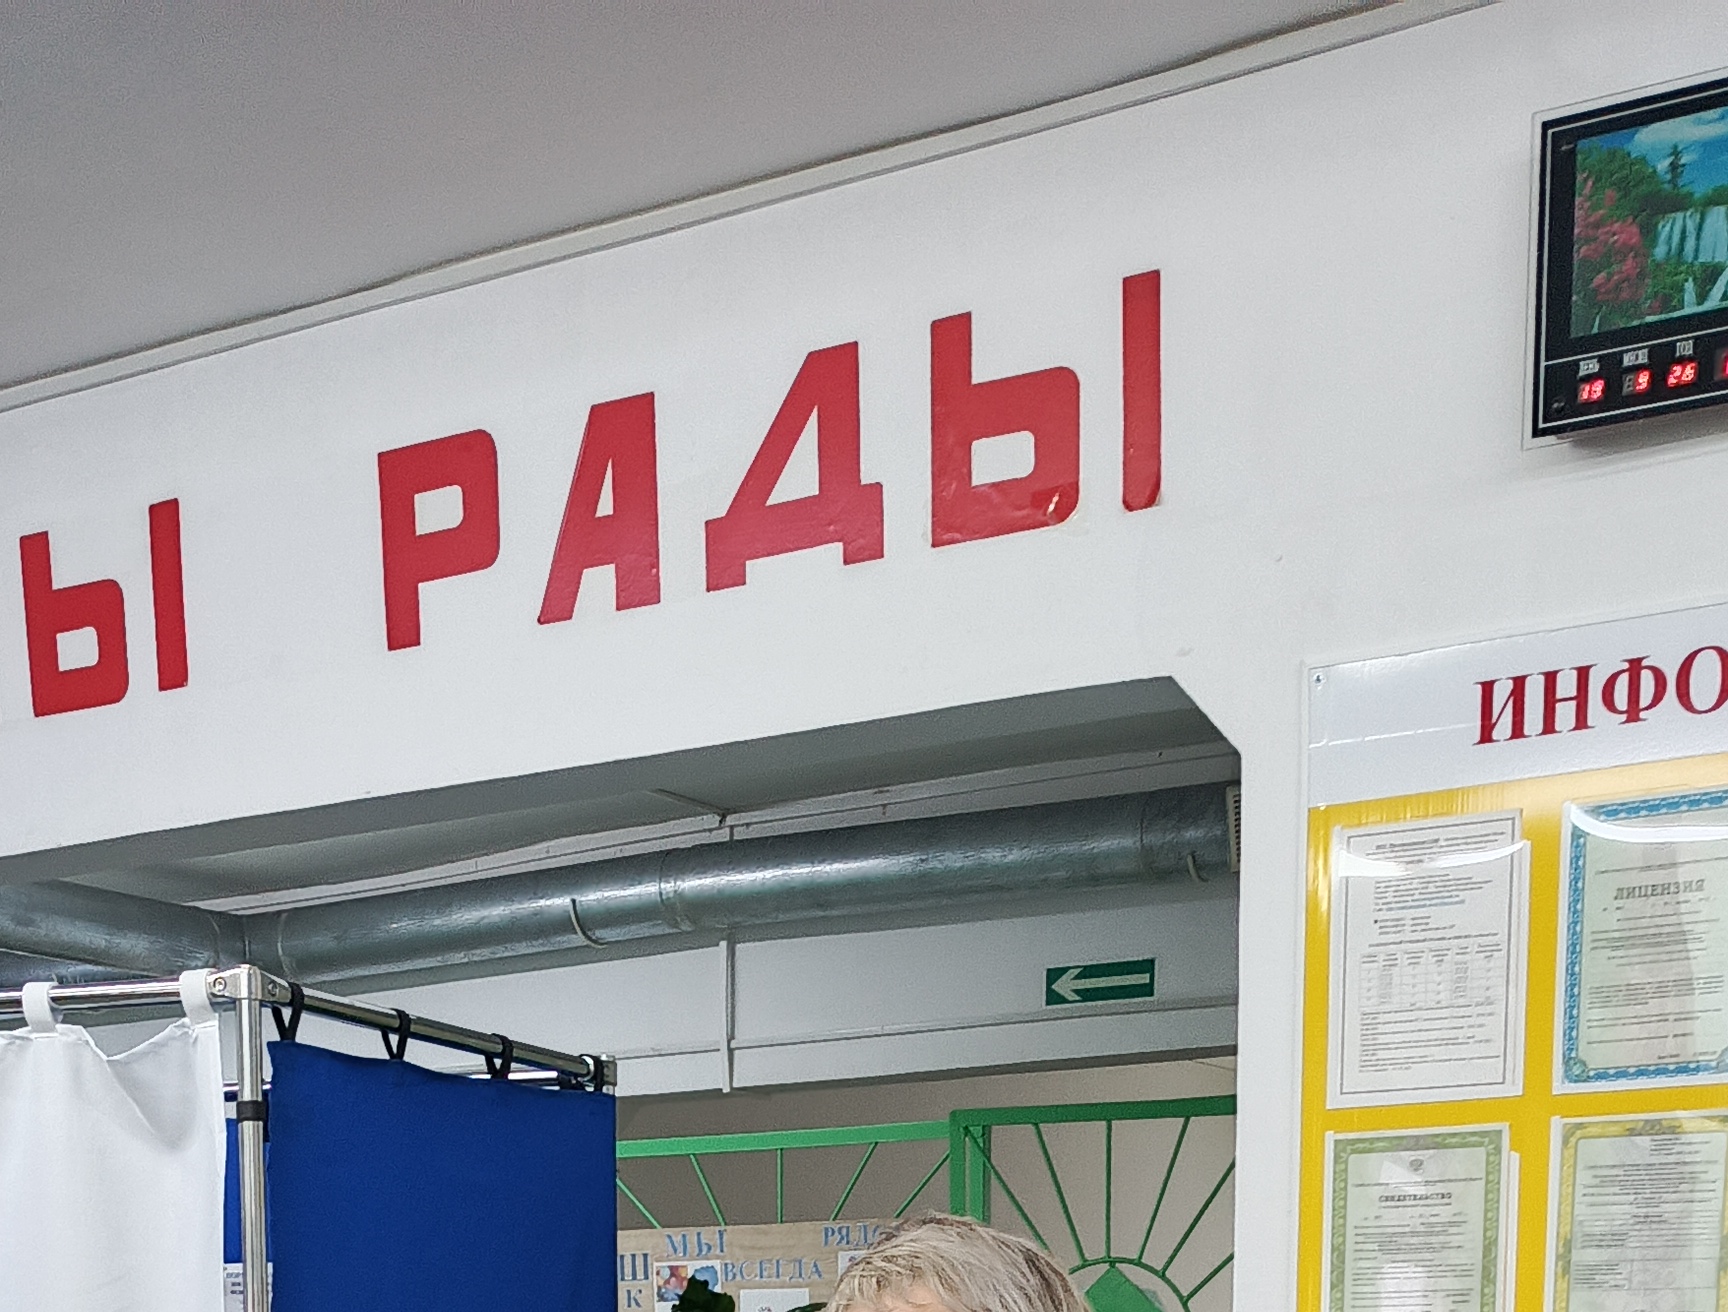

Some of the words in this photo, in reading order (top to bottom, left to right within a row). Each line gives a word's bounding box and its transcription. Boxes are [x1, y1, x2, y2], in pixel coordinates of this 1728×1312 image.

[1578, 379, 1605, 402] 19
[1667, 360, 1698, 388] 26
[20, 498, 189, 717] Ы
[378, 269, 1161, 651] РАДЫ
[1472, 645, 1728, 746] ИНФО
[1614, 879, 1705, 900] ЛИЦЕНЗИЯ
[665, 1229, 727, 1258] МЫ
[723, 1258, 823, 1282] ВСЕГДА
